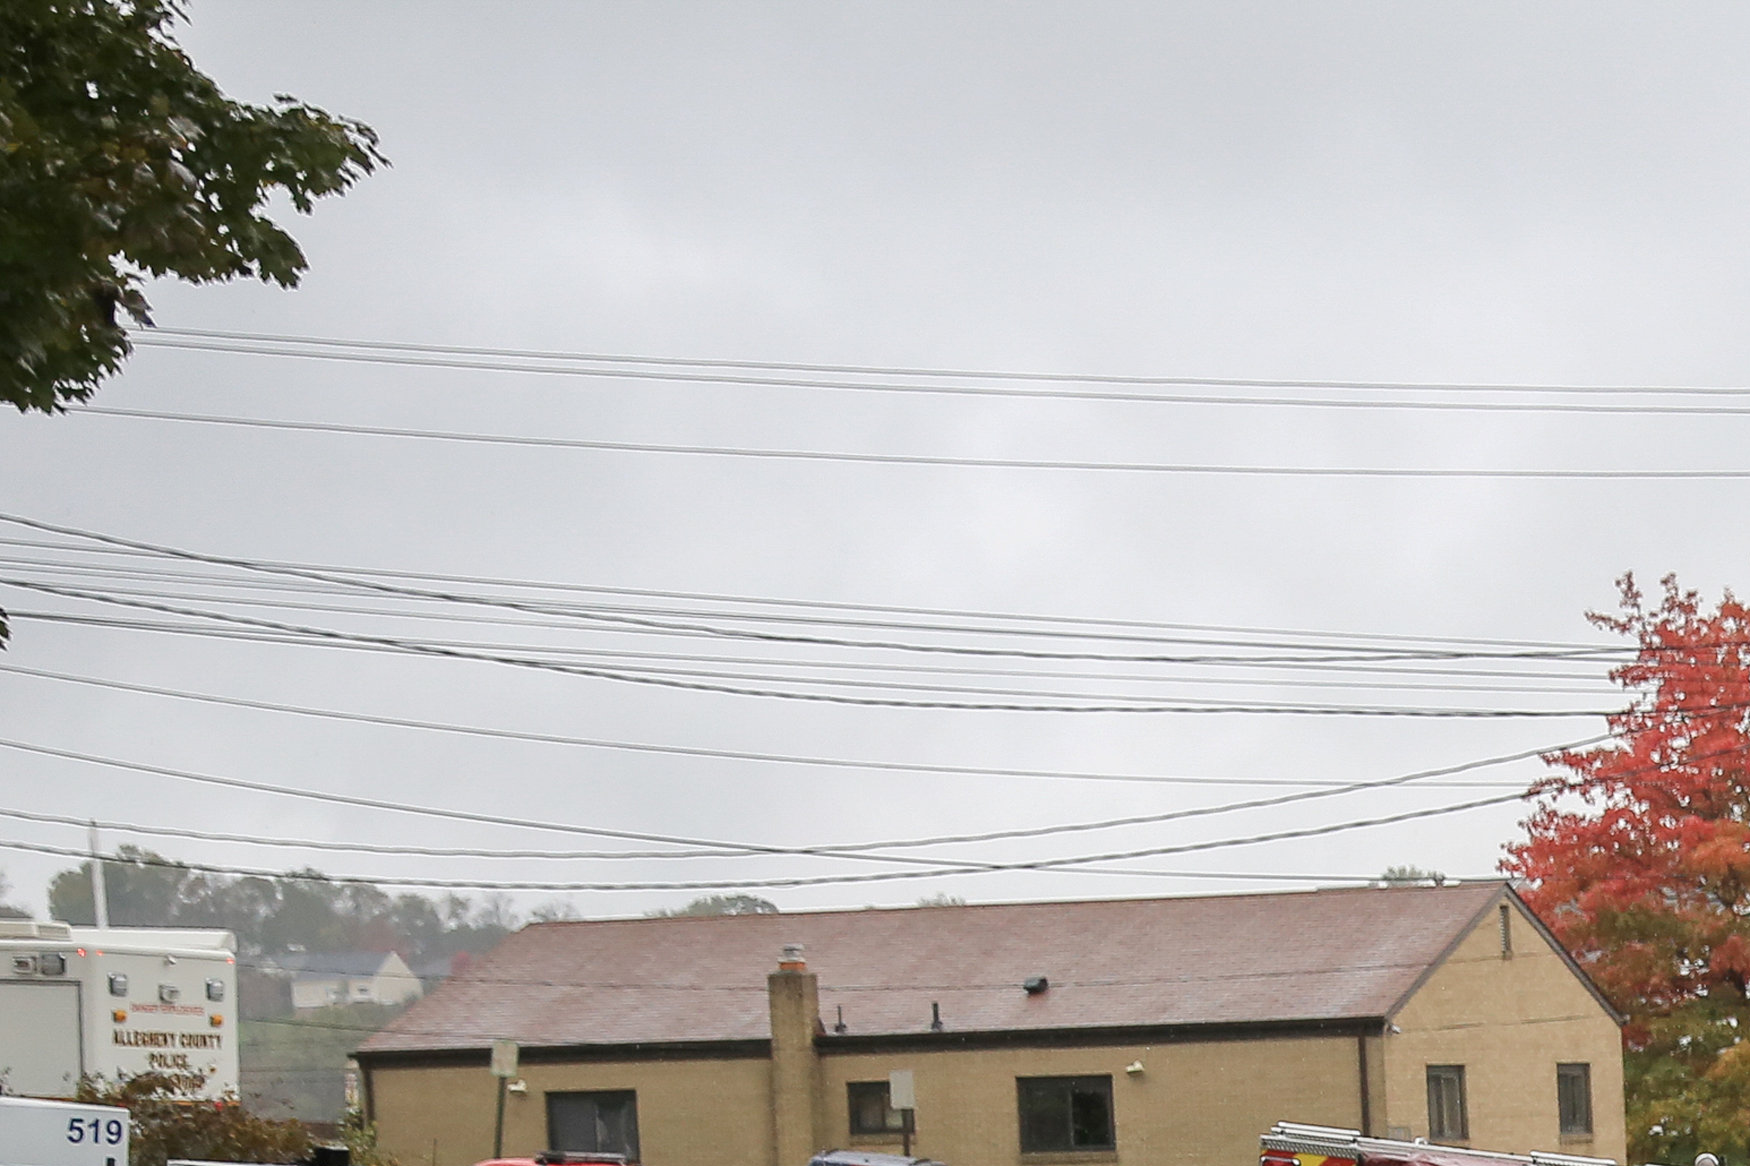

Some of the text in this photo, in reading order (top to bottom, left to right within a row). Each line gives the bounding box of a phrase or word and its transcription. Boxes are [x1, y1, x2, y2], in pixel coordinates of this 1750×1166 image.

[113, 1031, 222, 1049] ALLEGHENY COUNTY
[67, 1117, 122, 1145] 519
